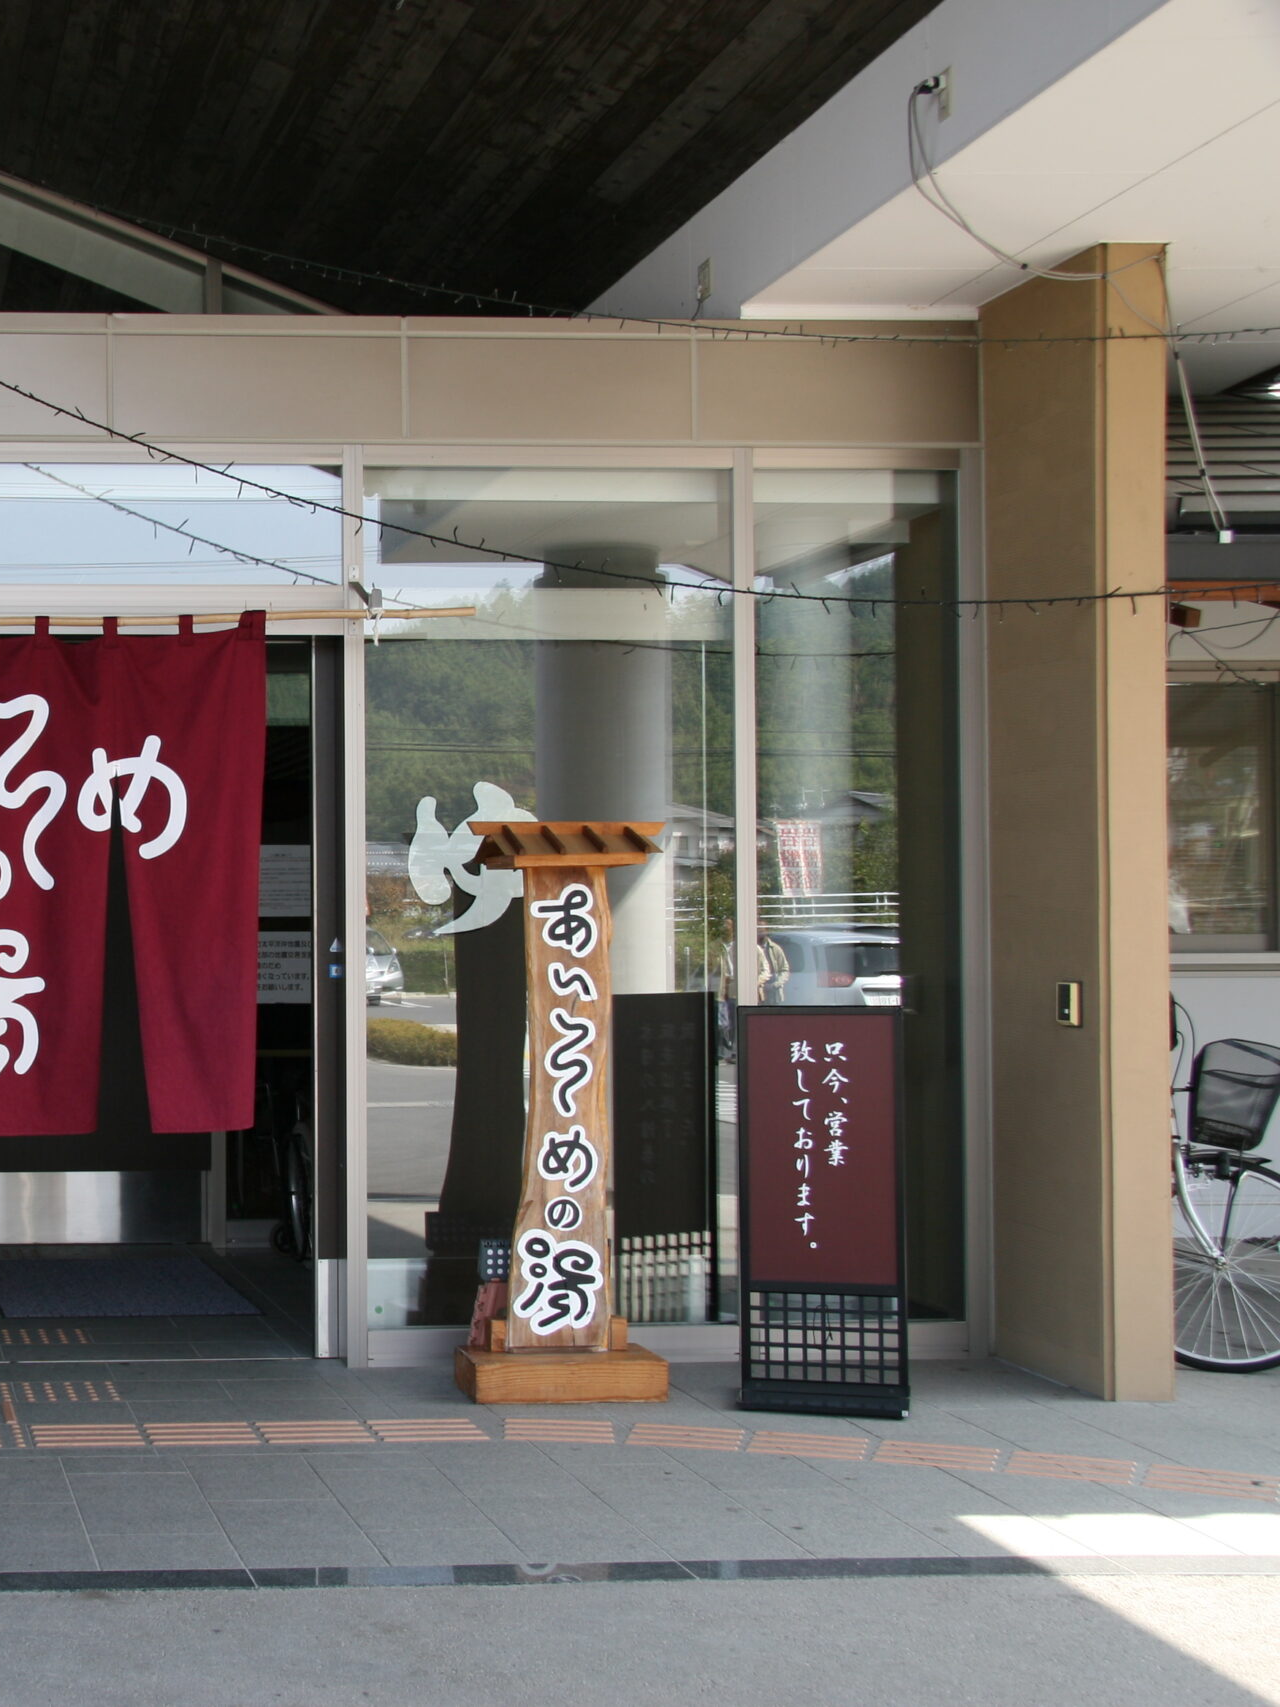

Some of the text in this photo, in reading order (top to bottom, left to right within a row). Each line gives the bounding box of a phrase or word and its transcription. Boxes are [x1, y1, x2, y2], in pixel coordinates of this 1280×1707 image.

[514, 883, 605, 1338] あいそめの湯
[790, 1040, 817, 1249] 致しております。
[821, 1041, 849, 1166] 只今、営業
